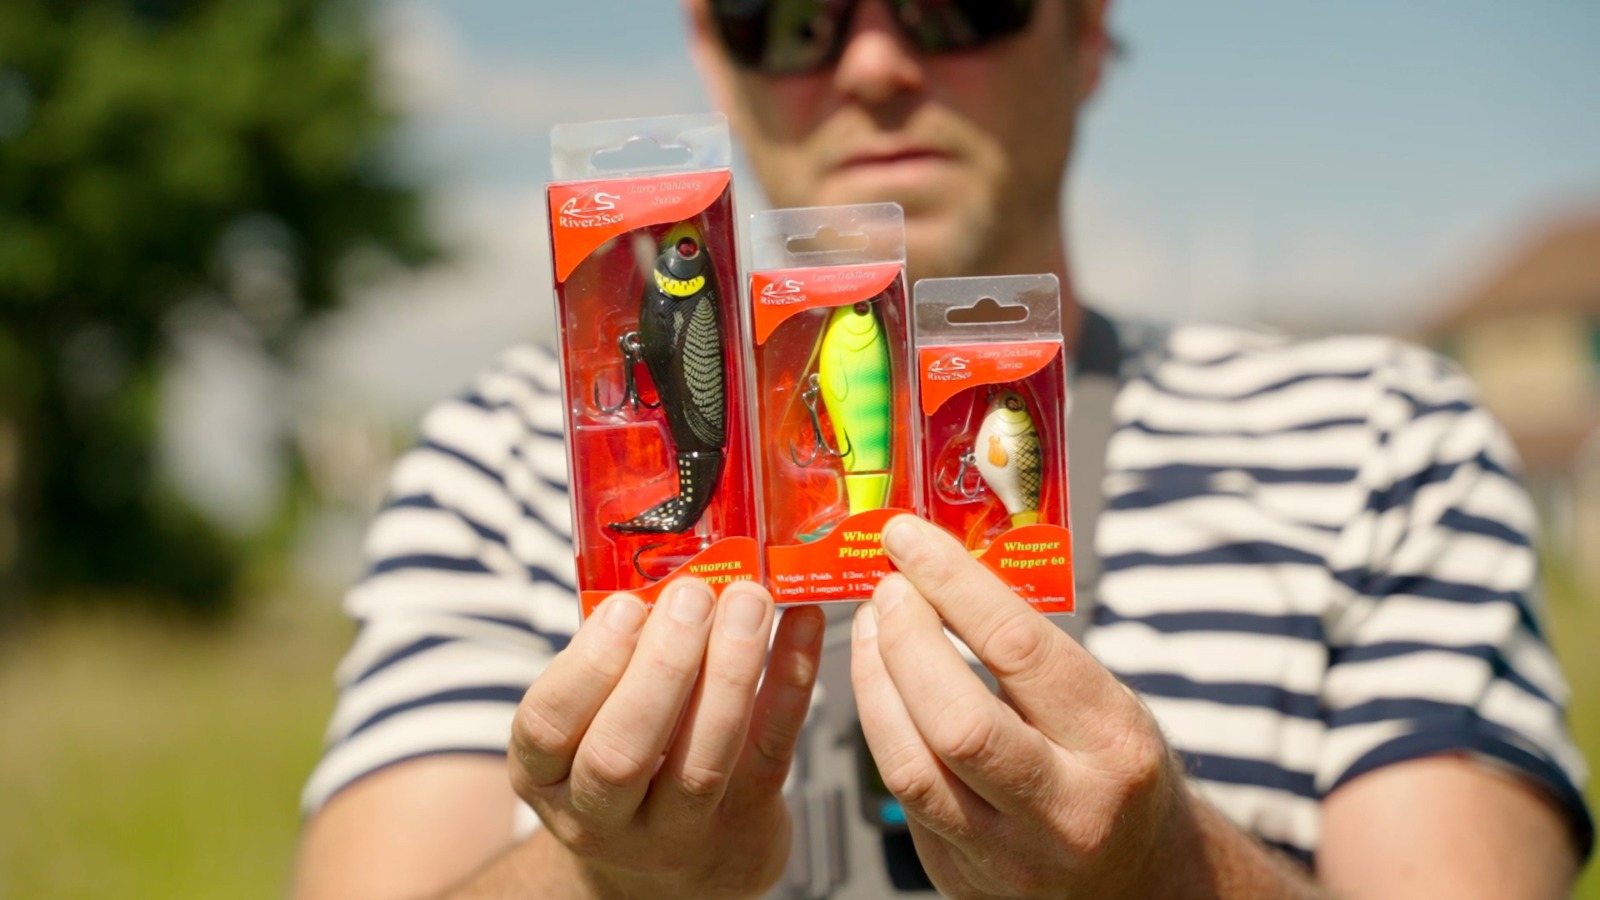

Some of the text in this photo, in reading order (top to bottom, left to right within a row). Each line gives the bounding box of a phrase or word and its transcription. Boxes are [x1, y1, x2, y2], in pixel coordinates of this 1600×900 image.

[629, 180, 702, 194] Larry Dahlberg
[653, 196, 681, 205] Series
[559, 212, 624, 228] River2Sea
[839, 271, 877, 280] Dahlberg
[1003, 348, 1042, 358] Dahlberg
[843, 531, 882, 542] Whop
[1004, 541, 1060, 552] Whopper
[839, 547, 886, 558] Ploppe
[689, 560, 742, 573] WHOPPER
[1000, 556, 1065, 569] Plopper 60
[776, 574, 805, 583] Weight
[811, 572, 833, 581] Poids
[776, 586, 805, 595] Length
